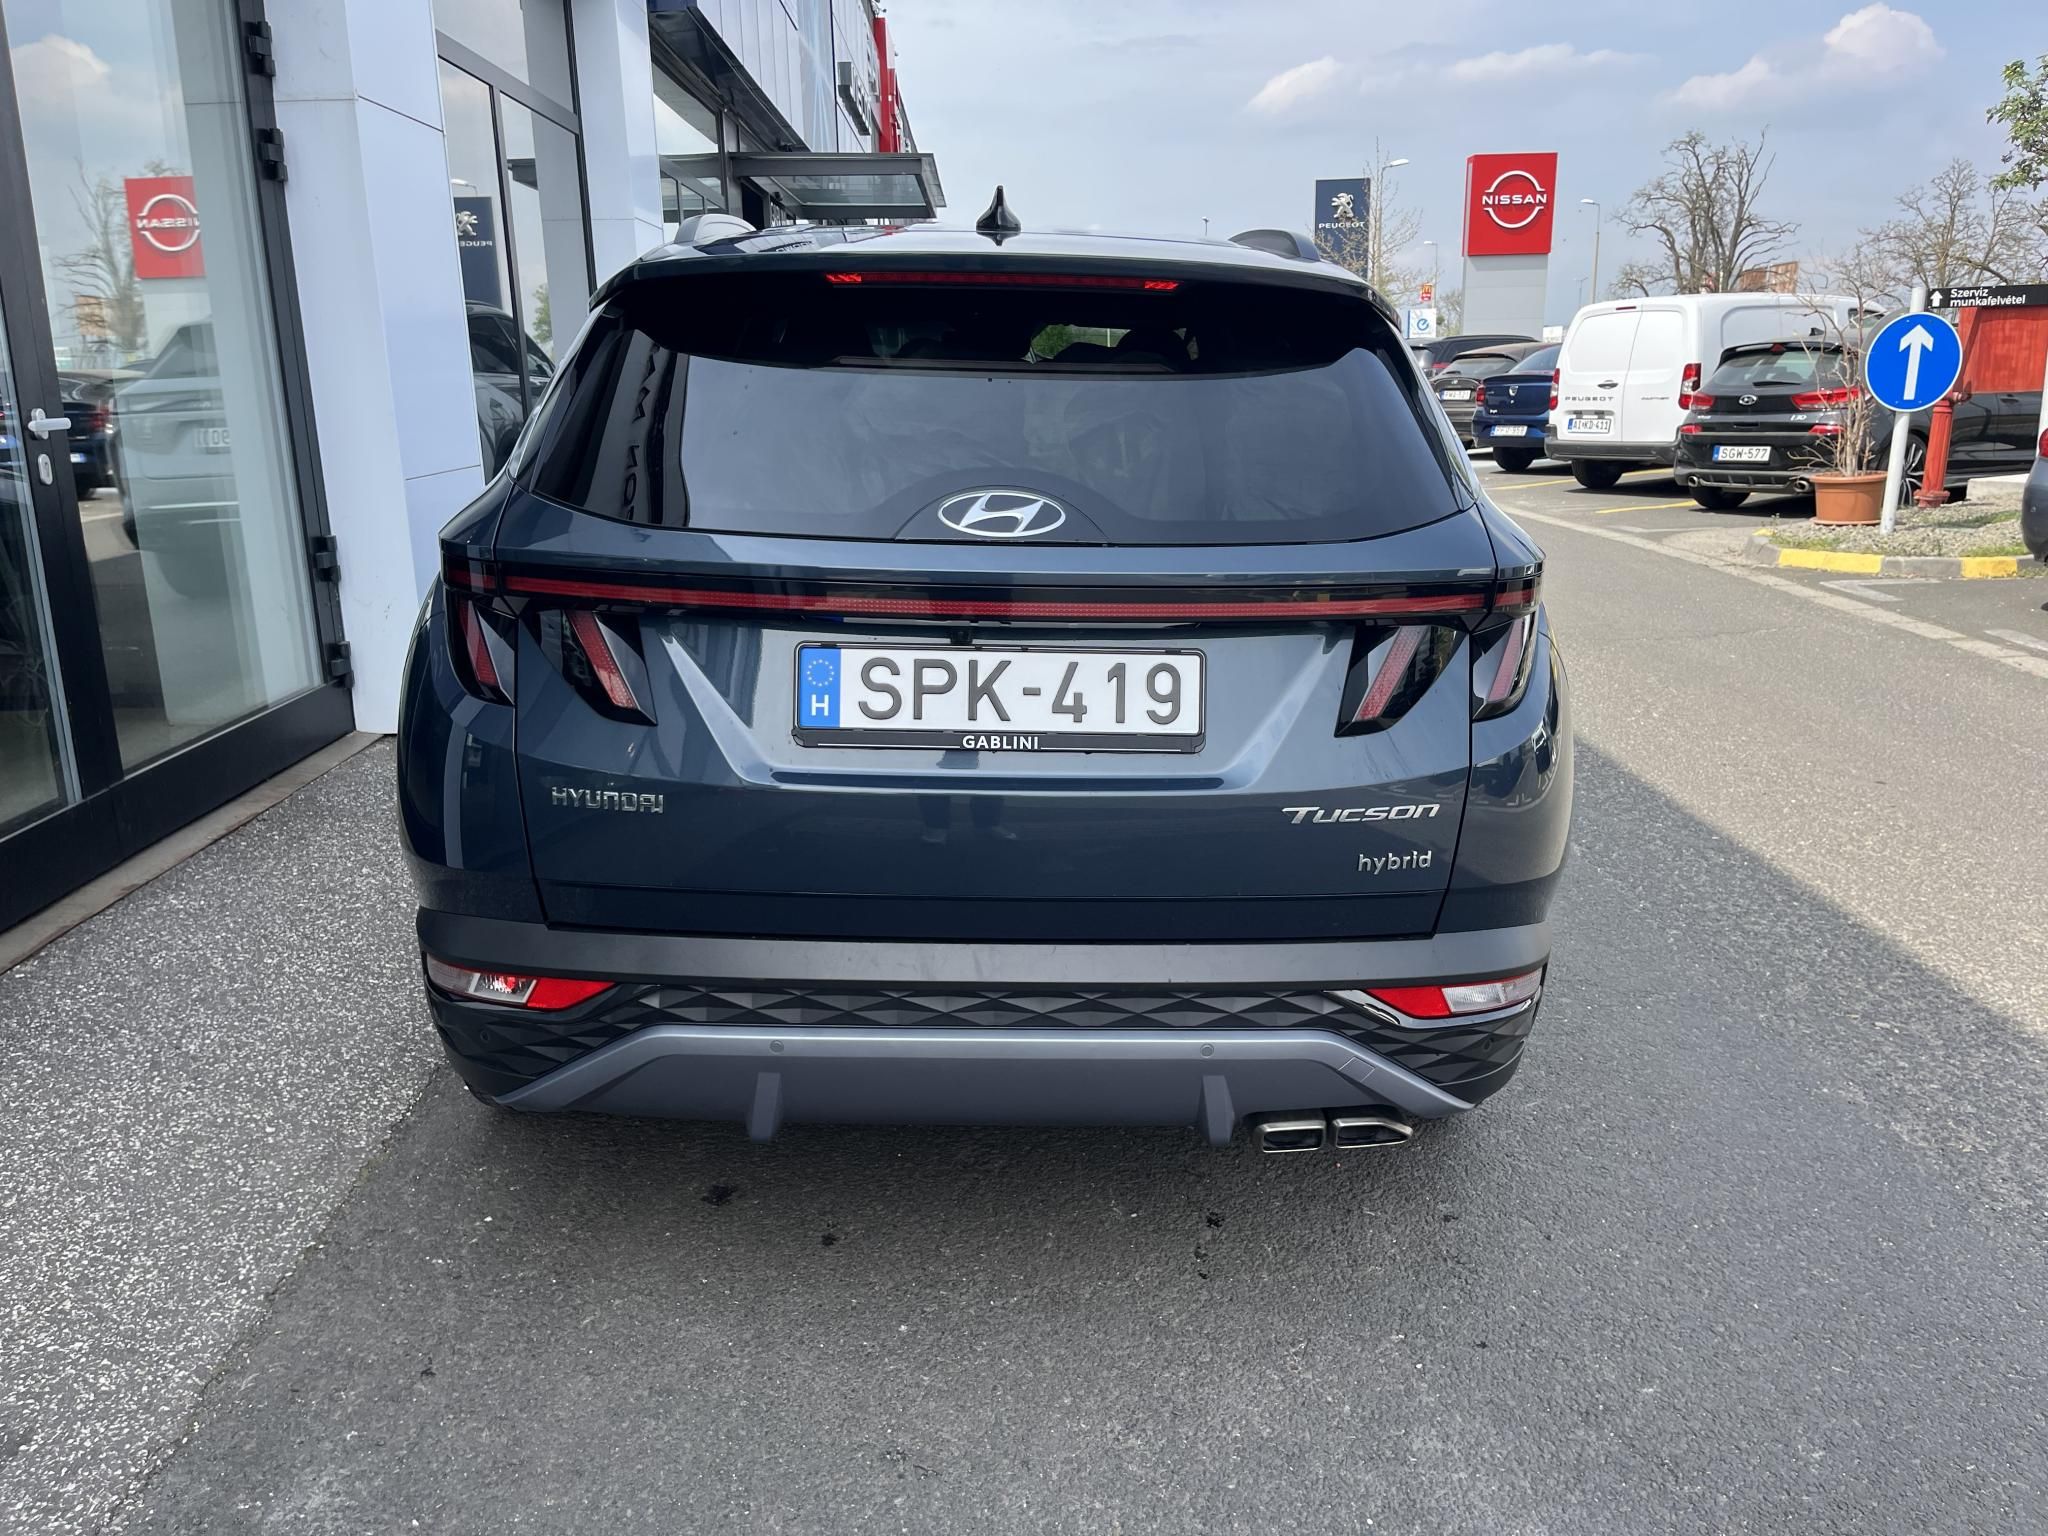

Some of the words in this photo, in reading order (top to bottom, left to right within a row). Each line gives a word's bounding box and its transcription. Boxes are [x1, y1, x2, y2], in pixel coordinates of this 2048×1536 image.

[1482, 193, 1547, 205] NISSAN
[1950, 287, 1989, 298] Szerviz
[1950, 294, 2026, 307] munkafelvétel
[1720, 448, 1768, 459] SGW-577
[858, 657, 1182, 725] SPK-419
[962, 735, 1039, 751] GABLINI
[551, 786, 664, 814] HYUNDAI
[1357, 850, 1432, 875] hybrid
